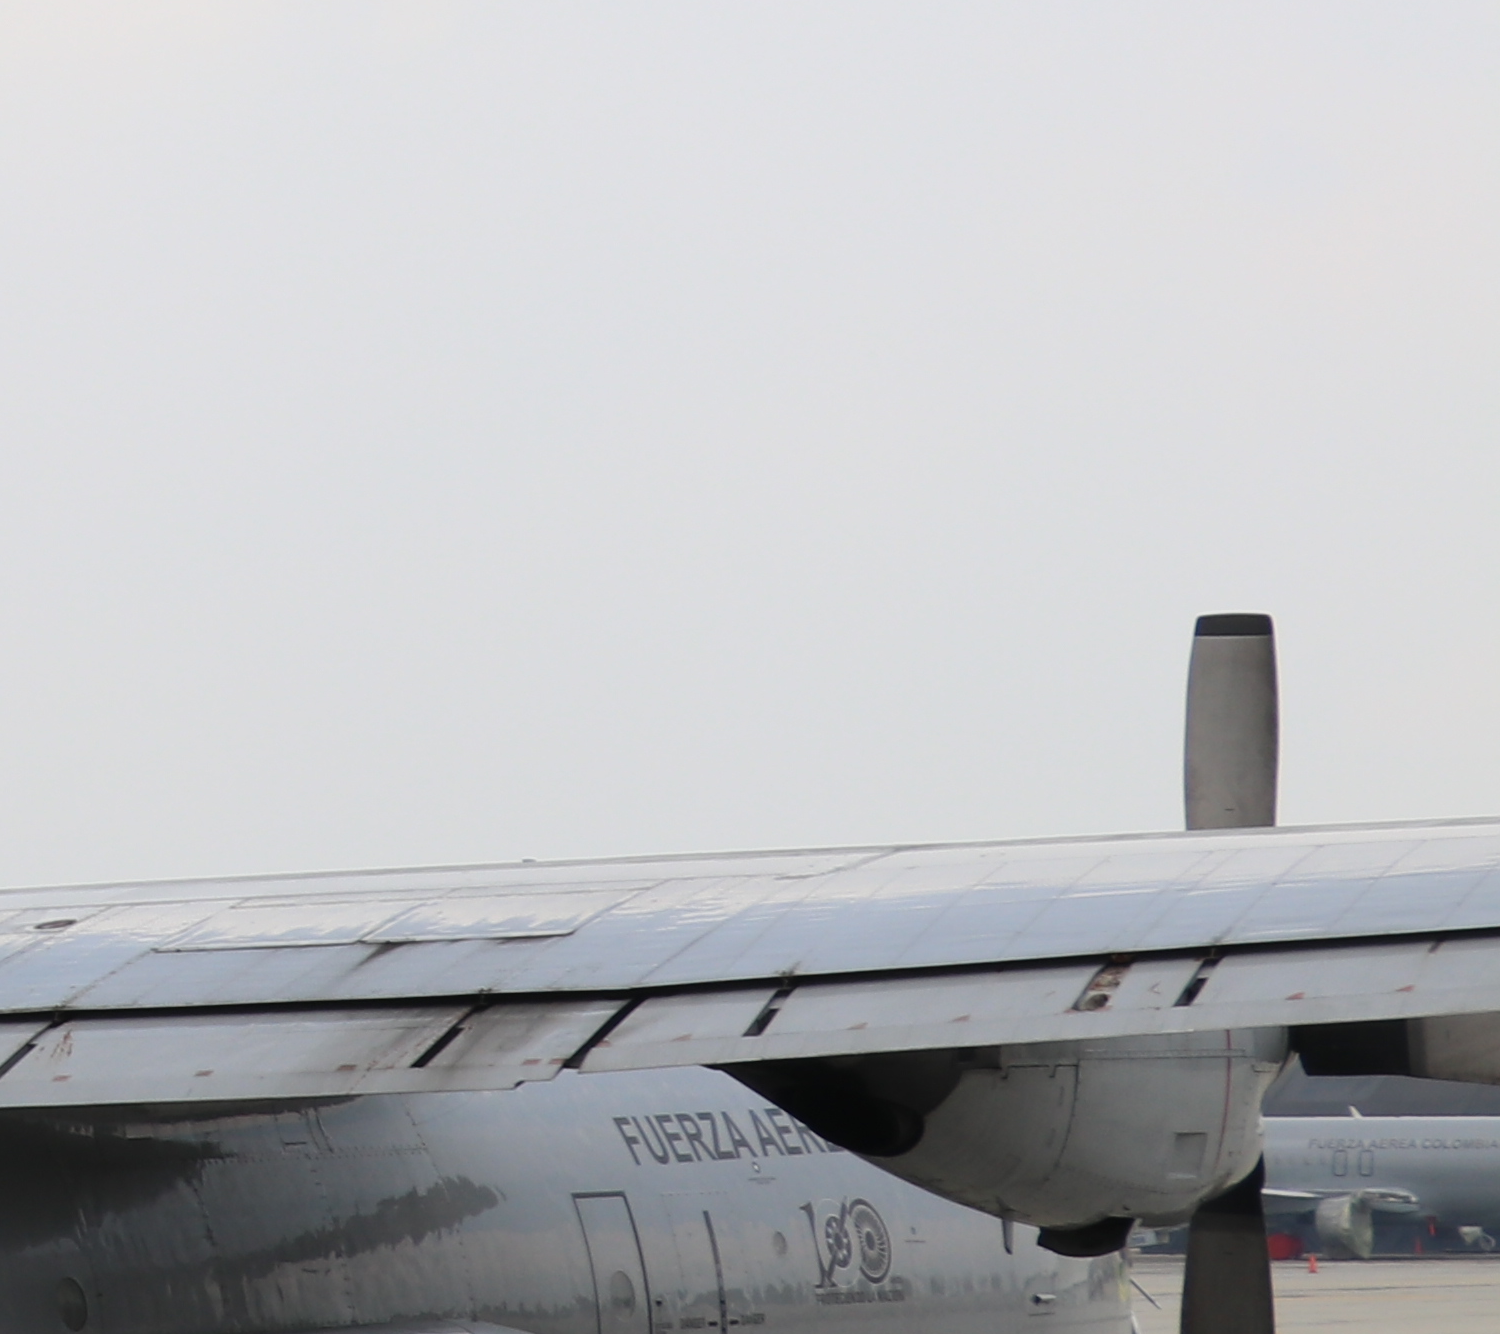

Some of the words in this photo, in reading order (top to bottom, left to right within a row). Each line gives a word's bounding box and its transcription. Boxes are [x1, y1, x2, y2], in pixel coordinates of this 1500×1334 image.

[612, 1111, 755, 1165] FUERZA
[748, 1107, 849, 1156] AER
[1308, 1138, 1364, 1149] FUERZA
[1369, 1138, 1417, 1149] AEREA
